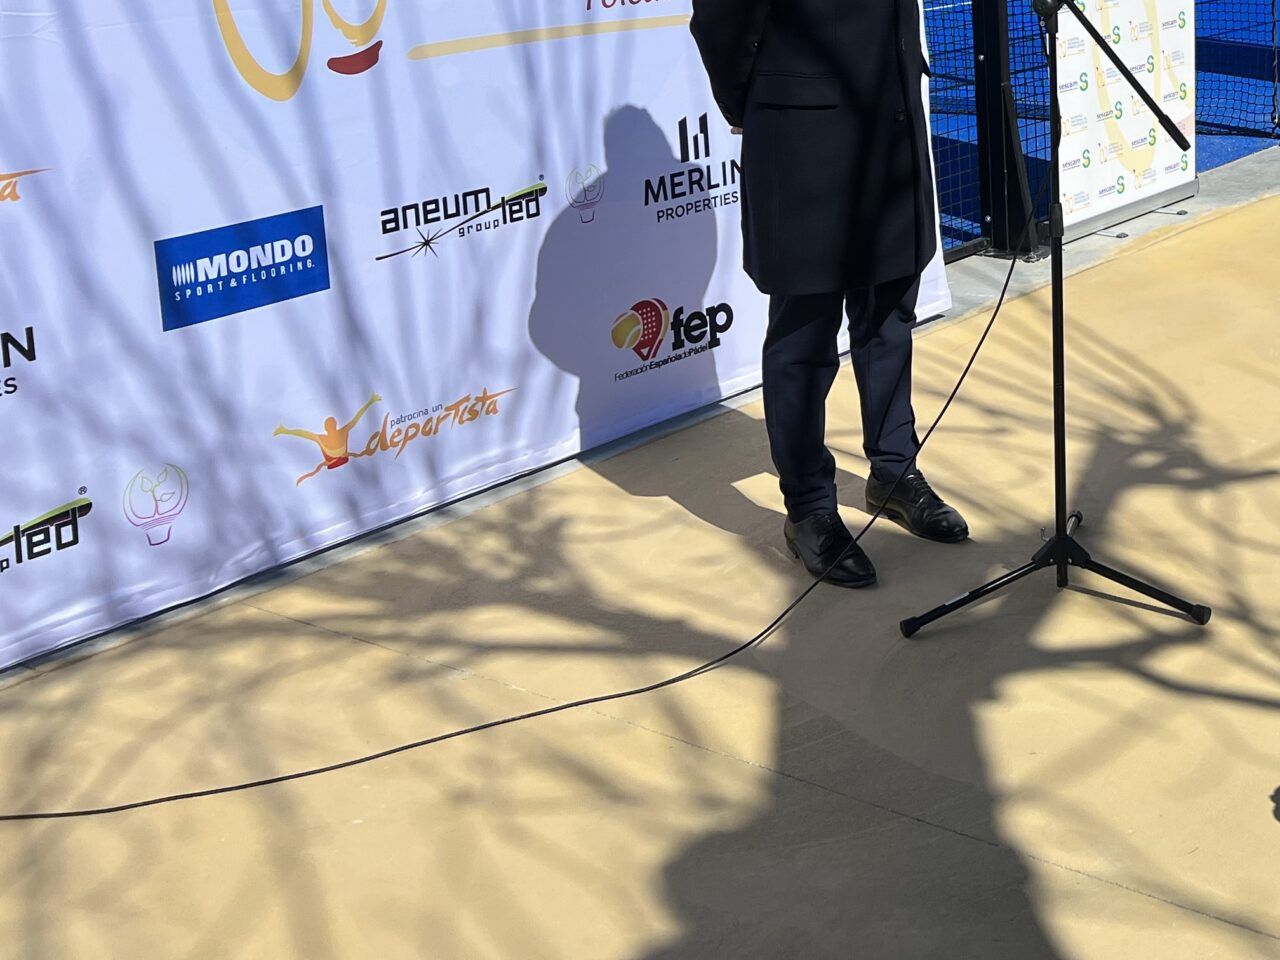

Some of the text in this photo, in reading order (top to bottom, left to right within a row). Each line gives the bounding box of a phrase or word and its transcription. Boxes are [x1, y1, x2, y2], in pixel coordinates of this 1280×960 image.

[380, 187, 541, 234] aneum led
[656, 191, 739, 223] PROPERTIES
[458, 219, 500, 238] group
[196, 234, 314, 282] MONDO
[174, 281, 223, 301] SPORT
[230, 278, 237, 287] &
[671, 302, 734, 352] fep
[390, 403, 443, 429] patrocina un
[13, 507, 79, 564] led
